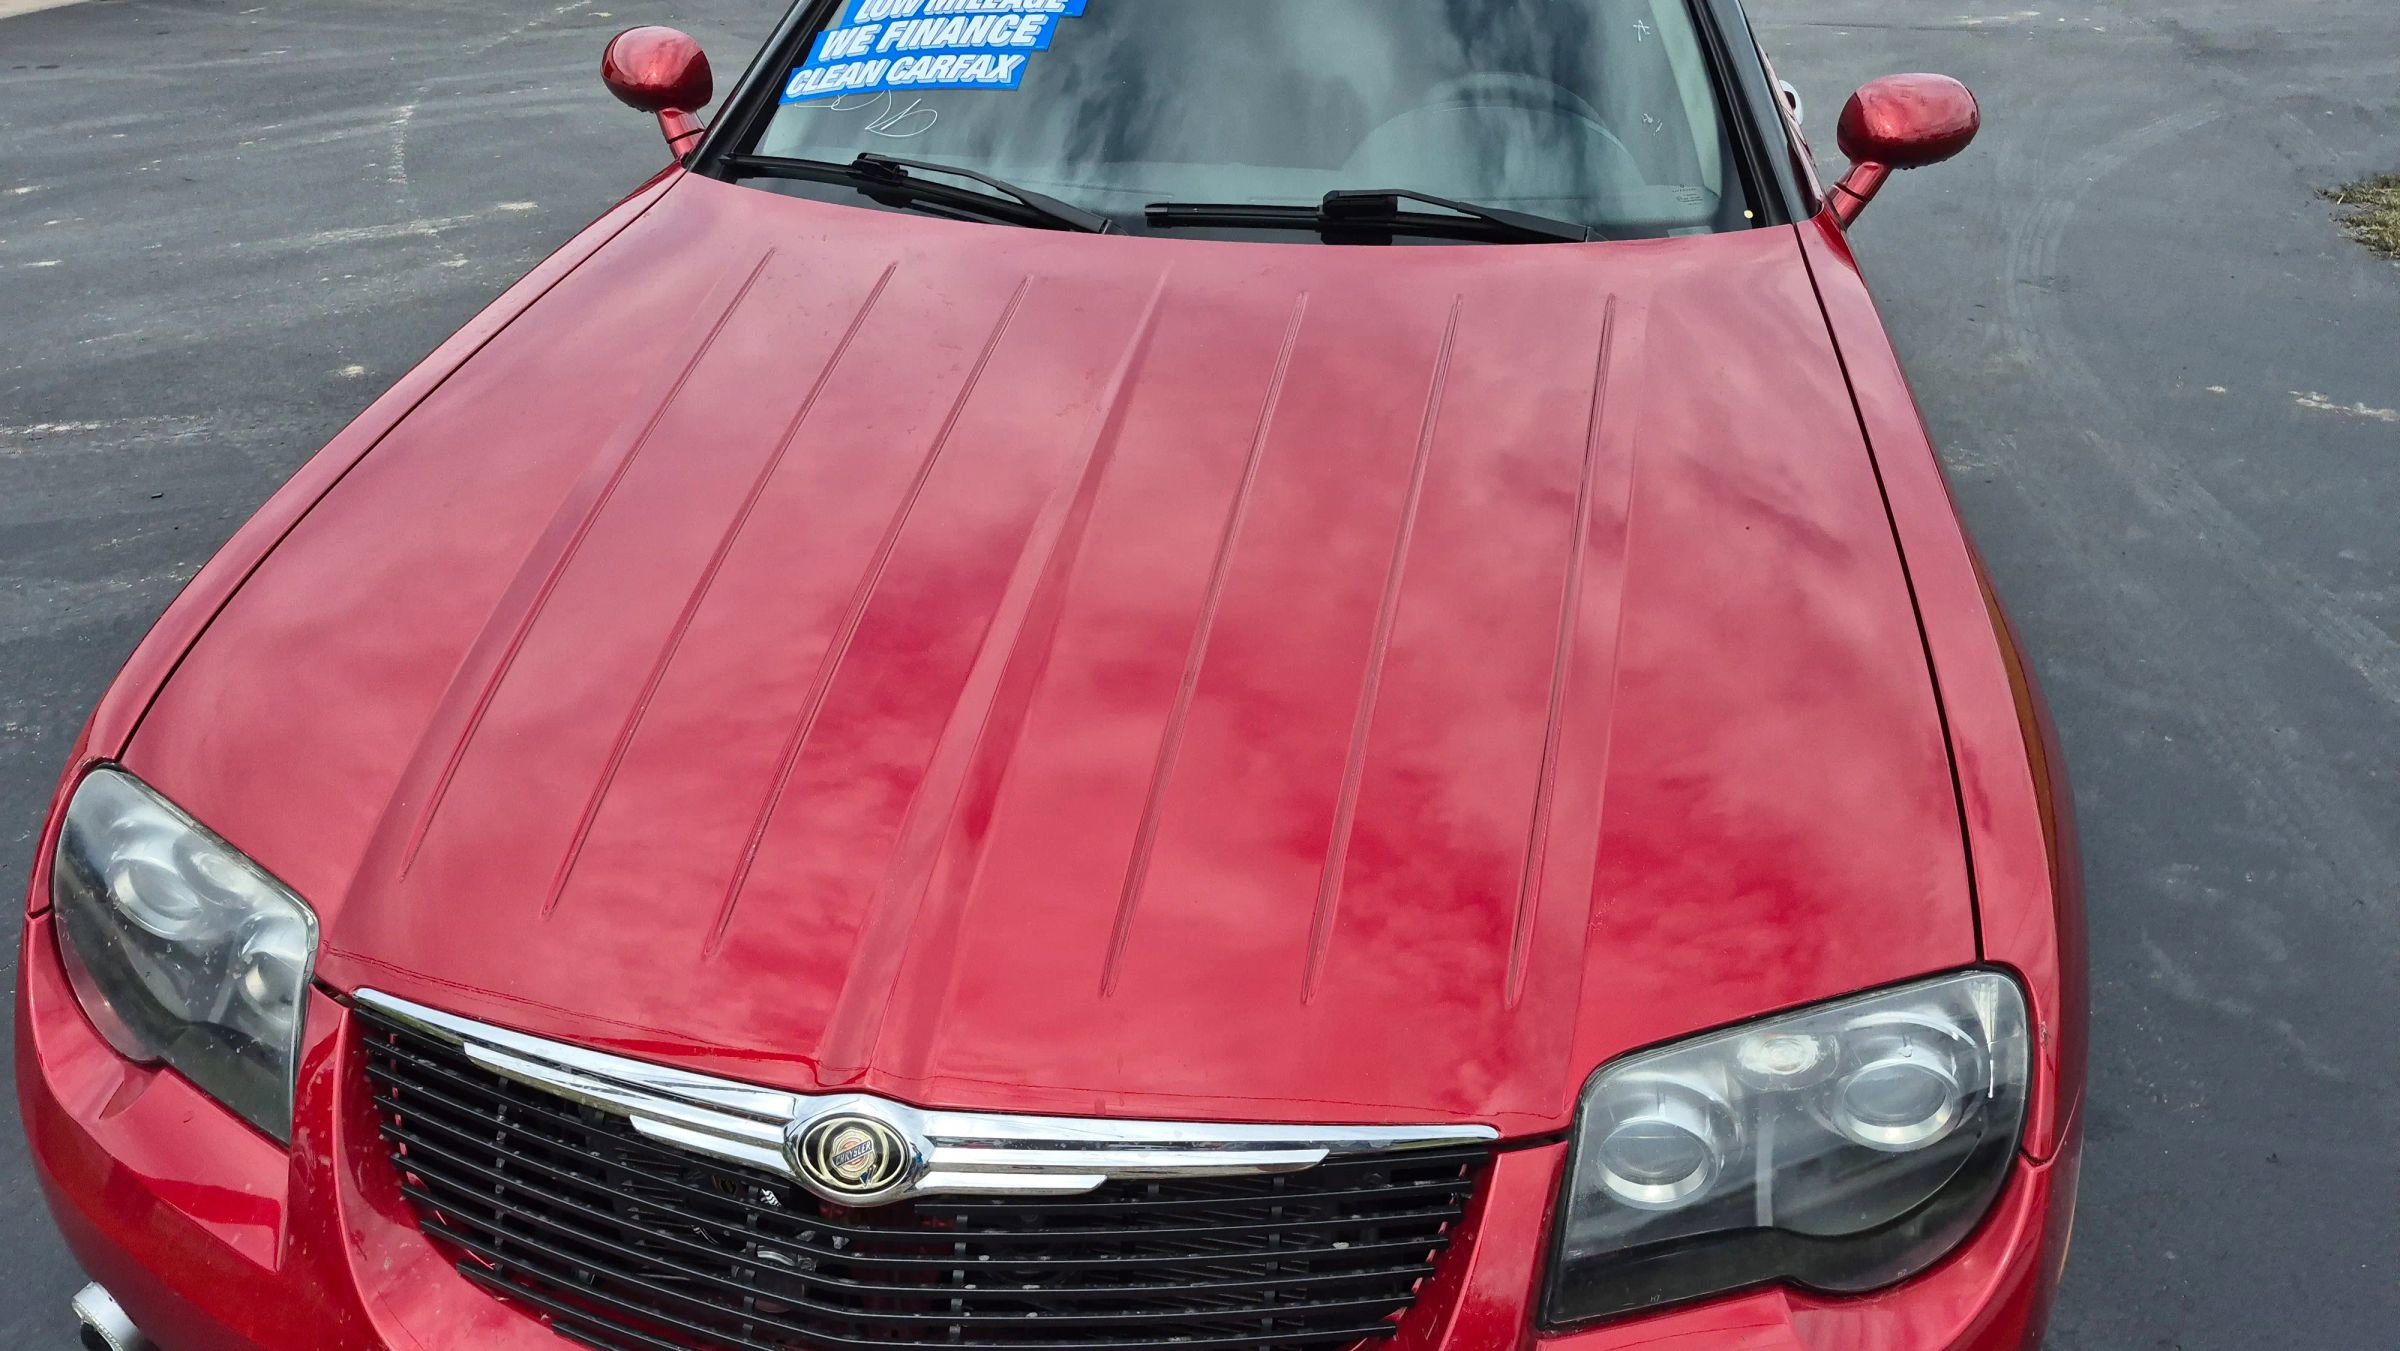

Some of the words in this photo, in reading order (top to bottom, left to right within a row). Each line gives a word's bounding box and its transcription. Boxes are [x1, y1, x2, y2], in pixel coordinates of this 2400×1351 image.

[818, 24, 882, 61] WE
[875, 14, 1049, 52] FINANCE
[785, 59, 891, 97] CLEAN
[886, 54, 1025, 83] CARFAX
[835, 1141, 871, 1165] CHRYSLER
